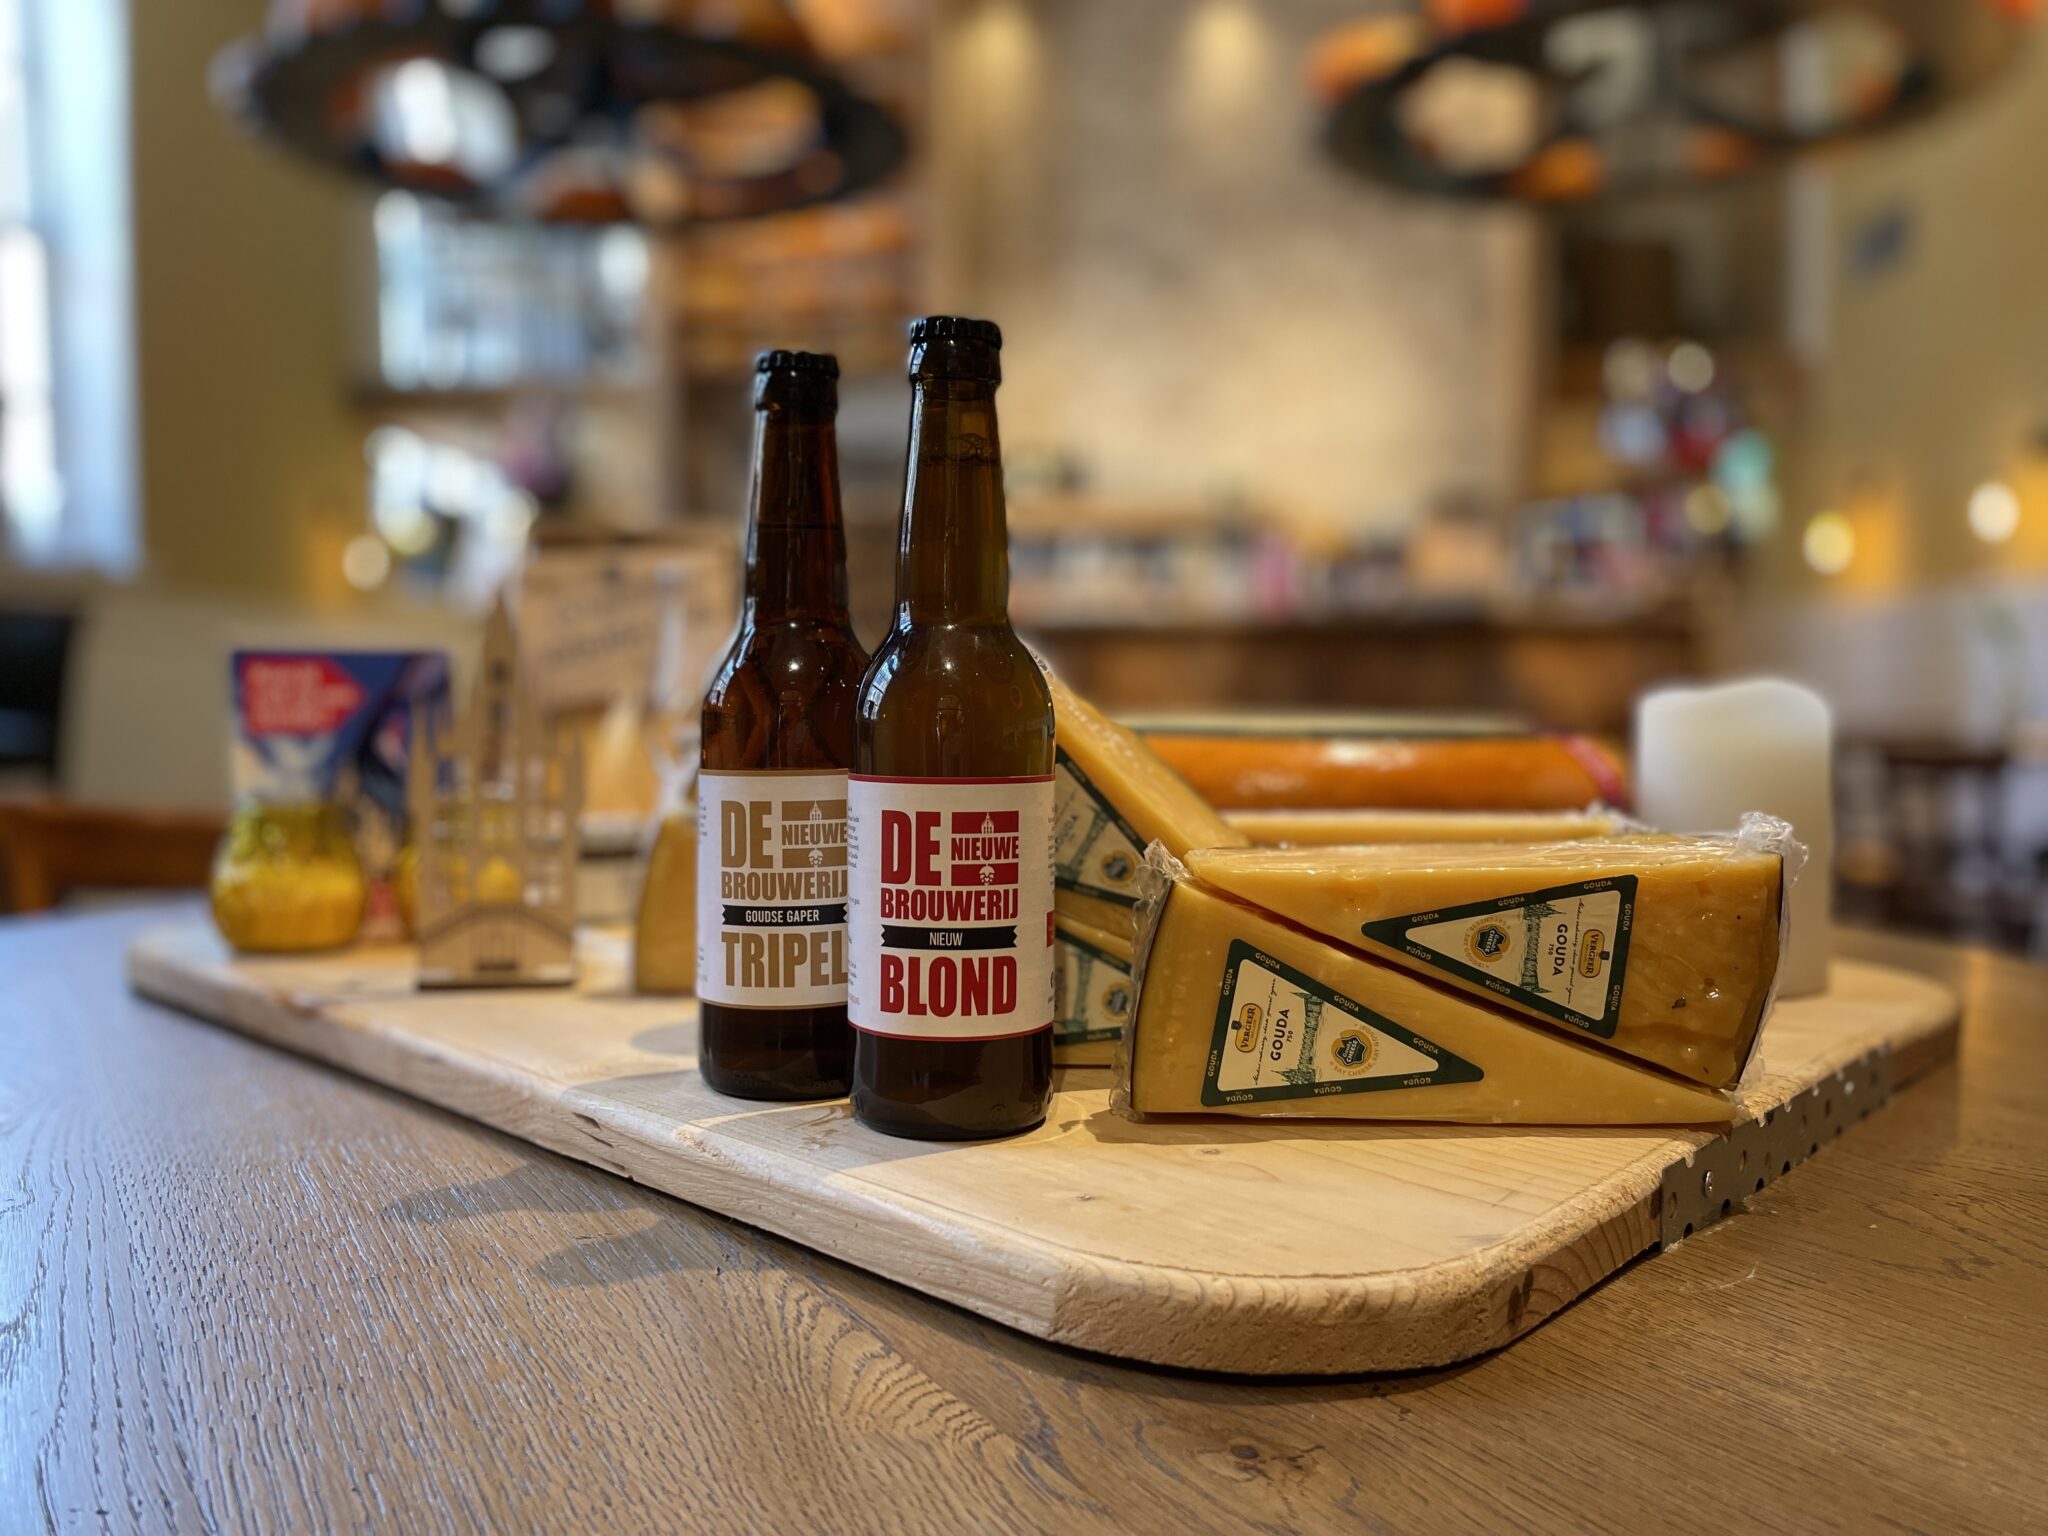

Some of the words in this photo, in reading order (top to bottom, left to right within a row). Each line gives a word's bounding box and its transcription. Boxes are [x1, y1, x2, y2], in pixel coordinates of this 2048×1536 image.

[721, 800, 773, 868] DE
[781, 823, 848, 846] NIEUWE
[881, 810, 941, 886] DE
[951, 836, 1020, 861] NIEUWE
[721, 871, 848, 901] BROUWERIJ
[1583, 880, 1612, 890] GOUDA
[881, 888, 1019, 922] BROUWERIJ
[1497, 896, 1526, 907] GOUDA
[745, 910, 784, 923] GOUDSE
[786, 909, 820, 922] GAPER
[1411, 912, 1440, 923] GOUDA
[1622, 903, 1632, 932] GOUDA
[929, 932, 963, 947] NIEUW
[1484, 930, 1496, 953] CHEESE
[1552, 923, 1568, 977] GOUDA
[721, 930, 848, 988] TRIPEL
[1254, 952, 1281, 971] GOUDA
[1405, 945, 1432, 961] GOUDA
[1584, 933, 1601, 975] VERGEER
[880, 954, 1017, 1018] BLOND
[1222, 967, 1234, 996] GOUDA
[1485, 979, 1511, 996] GOUDA
[1333, 995, 1360, 1013] GOUDA
[1611, 984, 1621, 1012] GOUDA
[1240, 1006, 1257, 1049] VERGEER
[1564, 1012, 1590, 1029] GOUDA
[1270, 1008, 1291, 1061] GOUDA
[1286, 1030, 1294, 1043] 750
[1412, 1037, 1439, 1055] GOUDA
[1346, 1039, 1358, 1063] CHEESE
[1207, 1049, 1219, 1077] GOUDA
[1313, 1085, 1342, 1095] GOUDA
[1403, 1077, 1432, 1086] GOUDA
[1225, 1093, 1254, 1103] GOUDA
